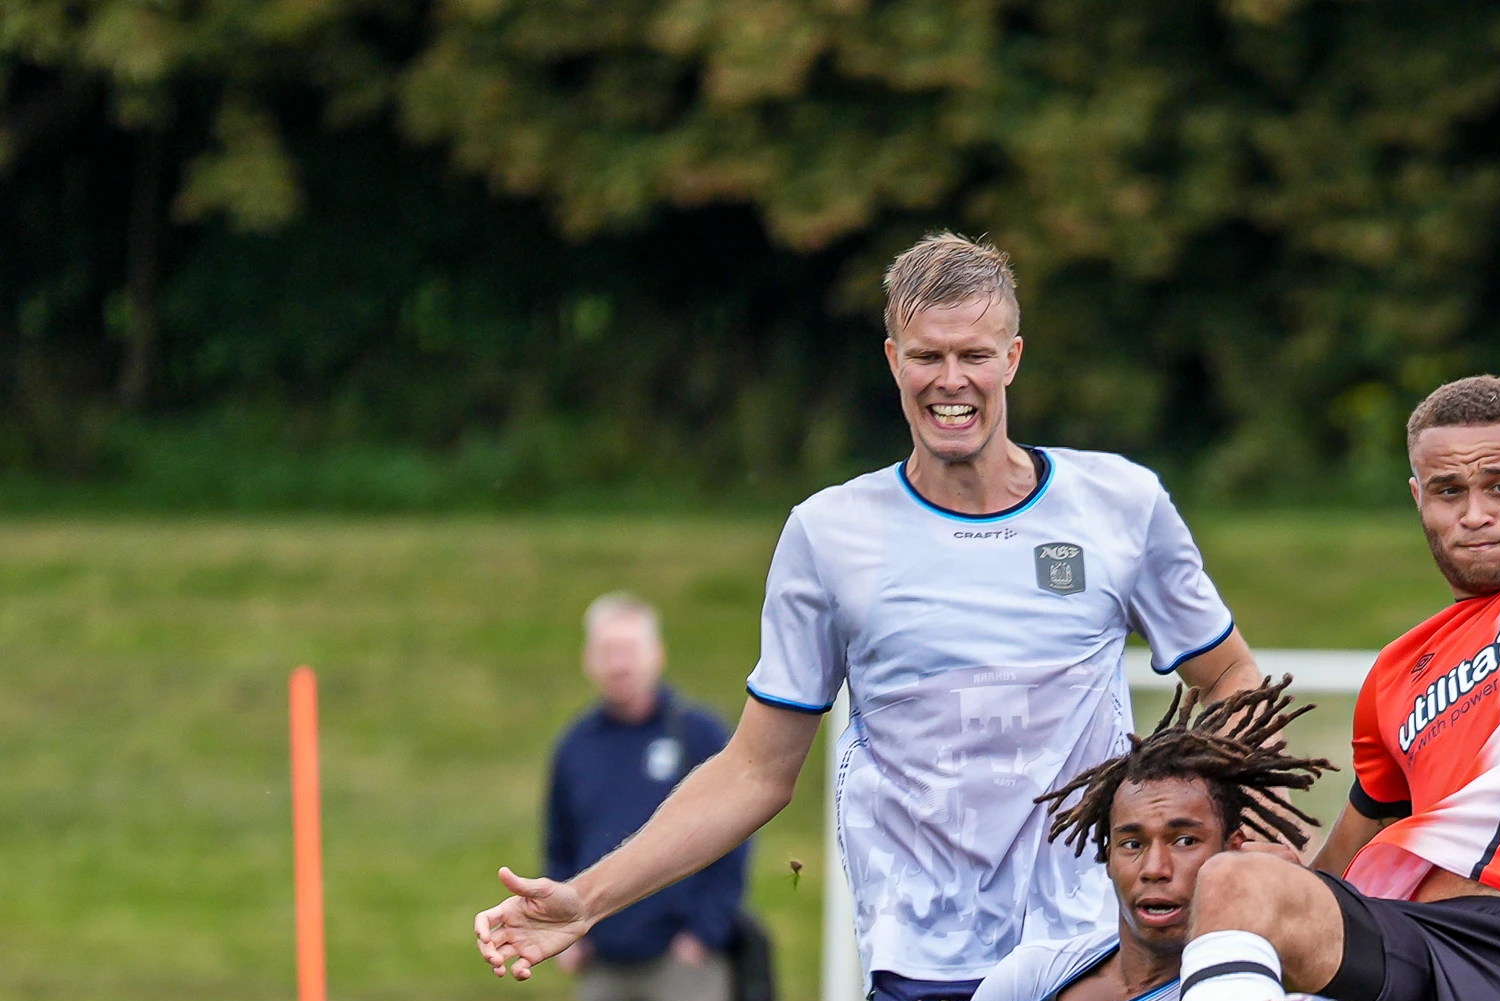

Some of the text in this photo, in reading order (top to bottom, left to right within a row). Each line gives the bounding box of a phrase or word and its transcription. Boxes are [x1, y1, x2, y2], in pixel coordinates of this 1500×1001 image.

[953, 530, 1002, 540] CRAFT
[1417, 677, 1499, 751] with power
